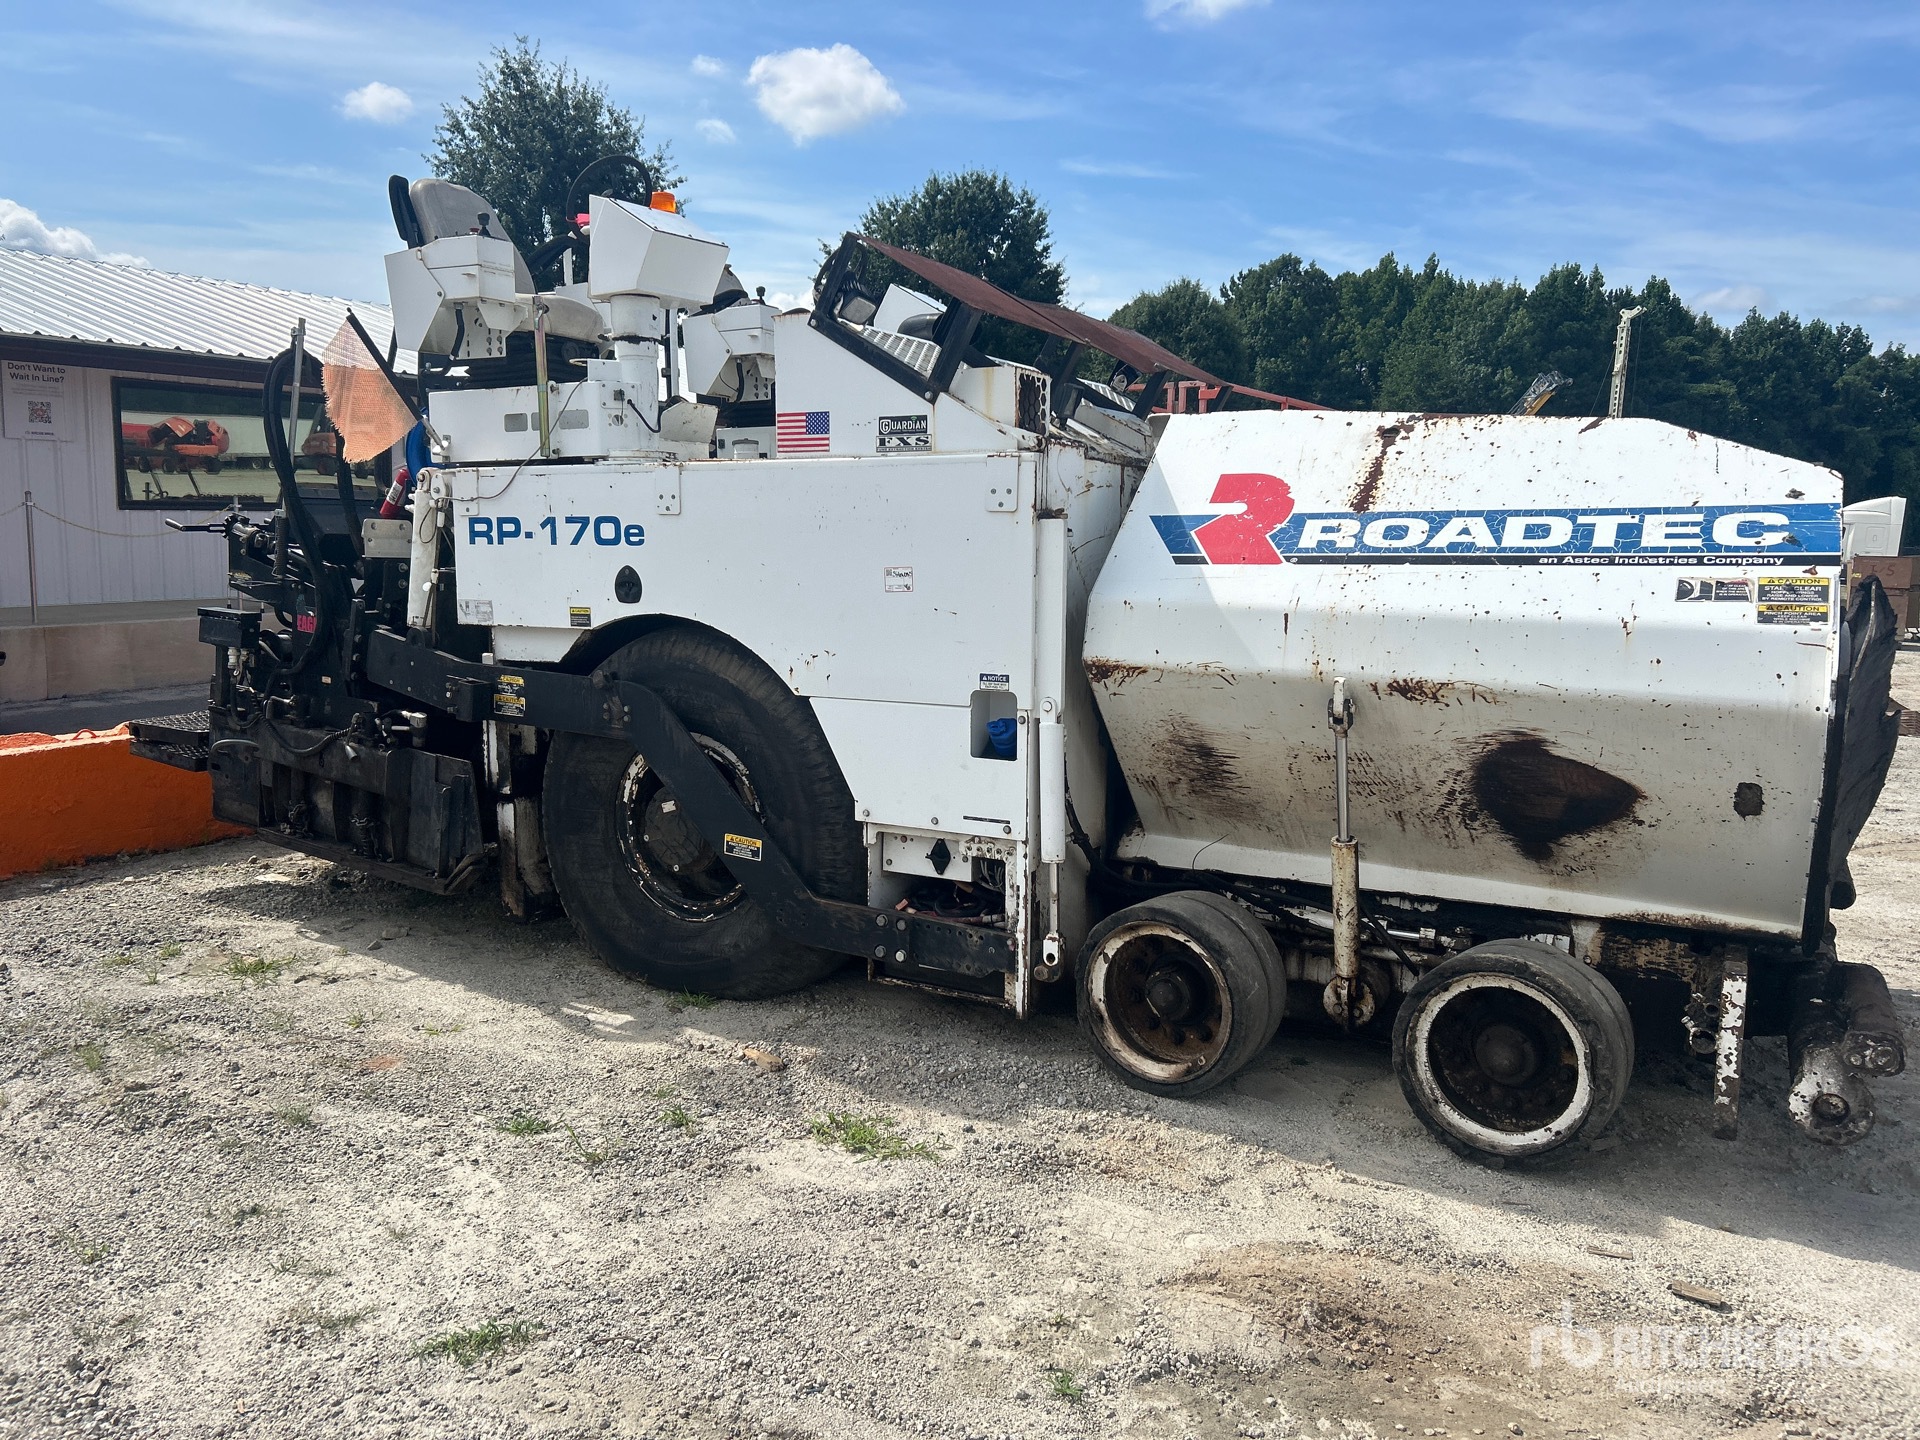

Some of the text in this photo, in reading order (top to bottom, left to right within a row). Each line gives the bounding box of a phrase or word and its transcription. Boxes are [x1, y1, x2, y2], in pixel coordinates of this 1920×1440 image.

[7, 362, 31, 371] Don't
[33, 364, 55, 373] Want
[9, 372, 30, 381] Wait
[42, 374, 65, 383] Line?
[878, 436, 930, 447] FXS
[468, 515, 645, 546] RP-170e
[1297, 512, 1790, 549] ROADTEC
[1538, 555, 1784, 566] an Astec Industries Company
[735, 837, 756, 845] CAUTION
